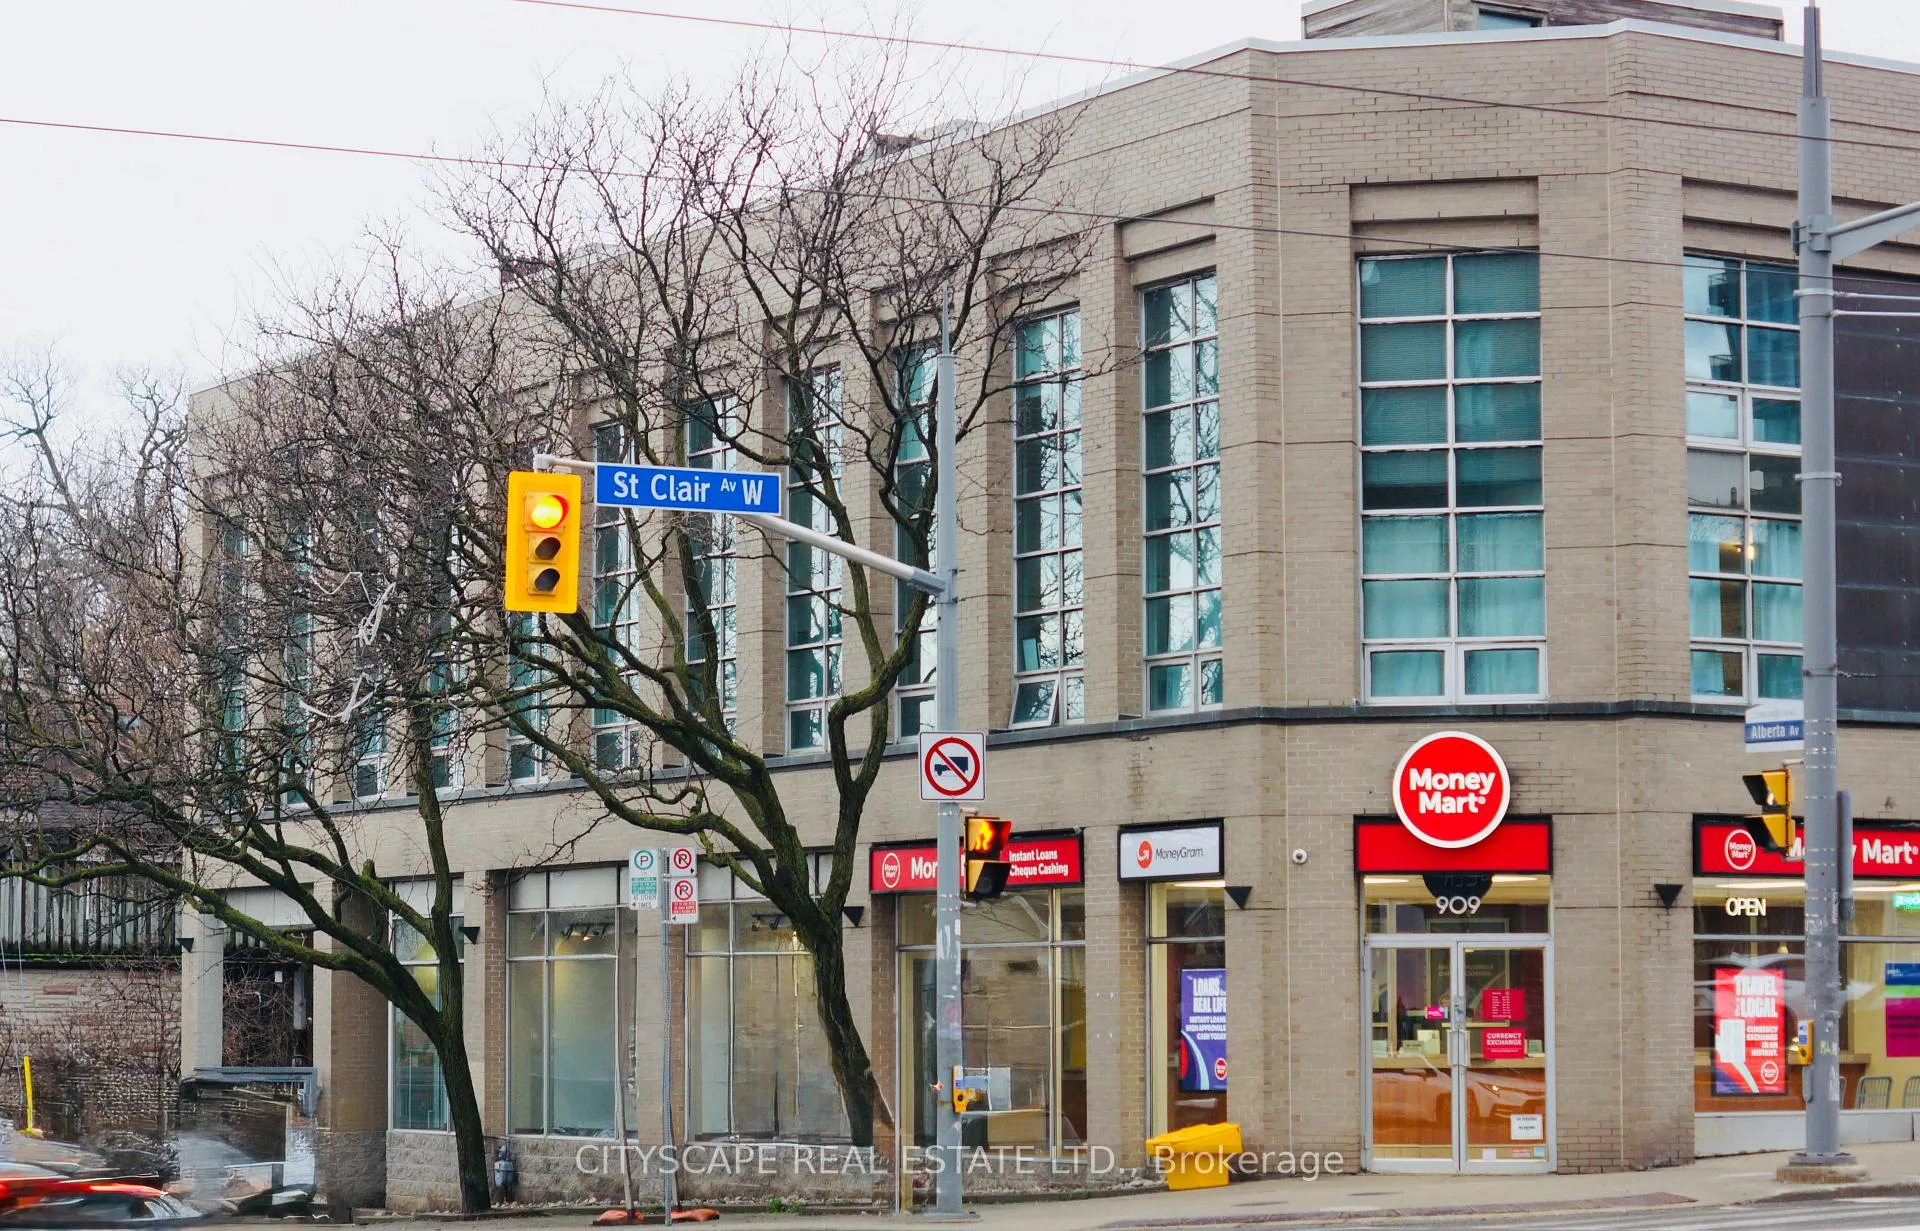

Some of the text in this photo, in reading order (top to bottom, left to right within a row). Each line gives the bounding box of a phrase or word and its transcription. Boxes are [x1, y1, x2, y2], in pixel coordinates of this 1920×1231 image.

[613, 471, 763, 506] St Clair Av W
[1751, 724, 1800, 739] Alberta Av
[1409, 768, 1496, 795] Money
[1009, 849, 1058, 862] Instant Loans
[1155, 846, 1204, 862] MoneyGram
[1729, 842, 1753, 853] Money
[1731, 850, 1748, 858] Mart
[1010, 862, 1069, 878] Cheque Cashing
[1436, 895, 1481, 915] 909
[1725, 898, 1767, 916] OPEN
[1734, 975, 1778, 995] TRAVEL
[1193, 997, 1211, 1013] REAL
[1741, 998, 1778, 1018] LOCAL
